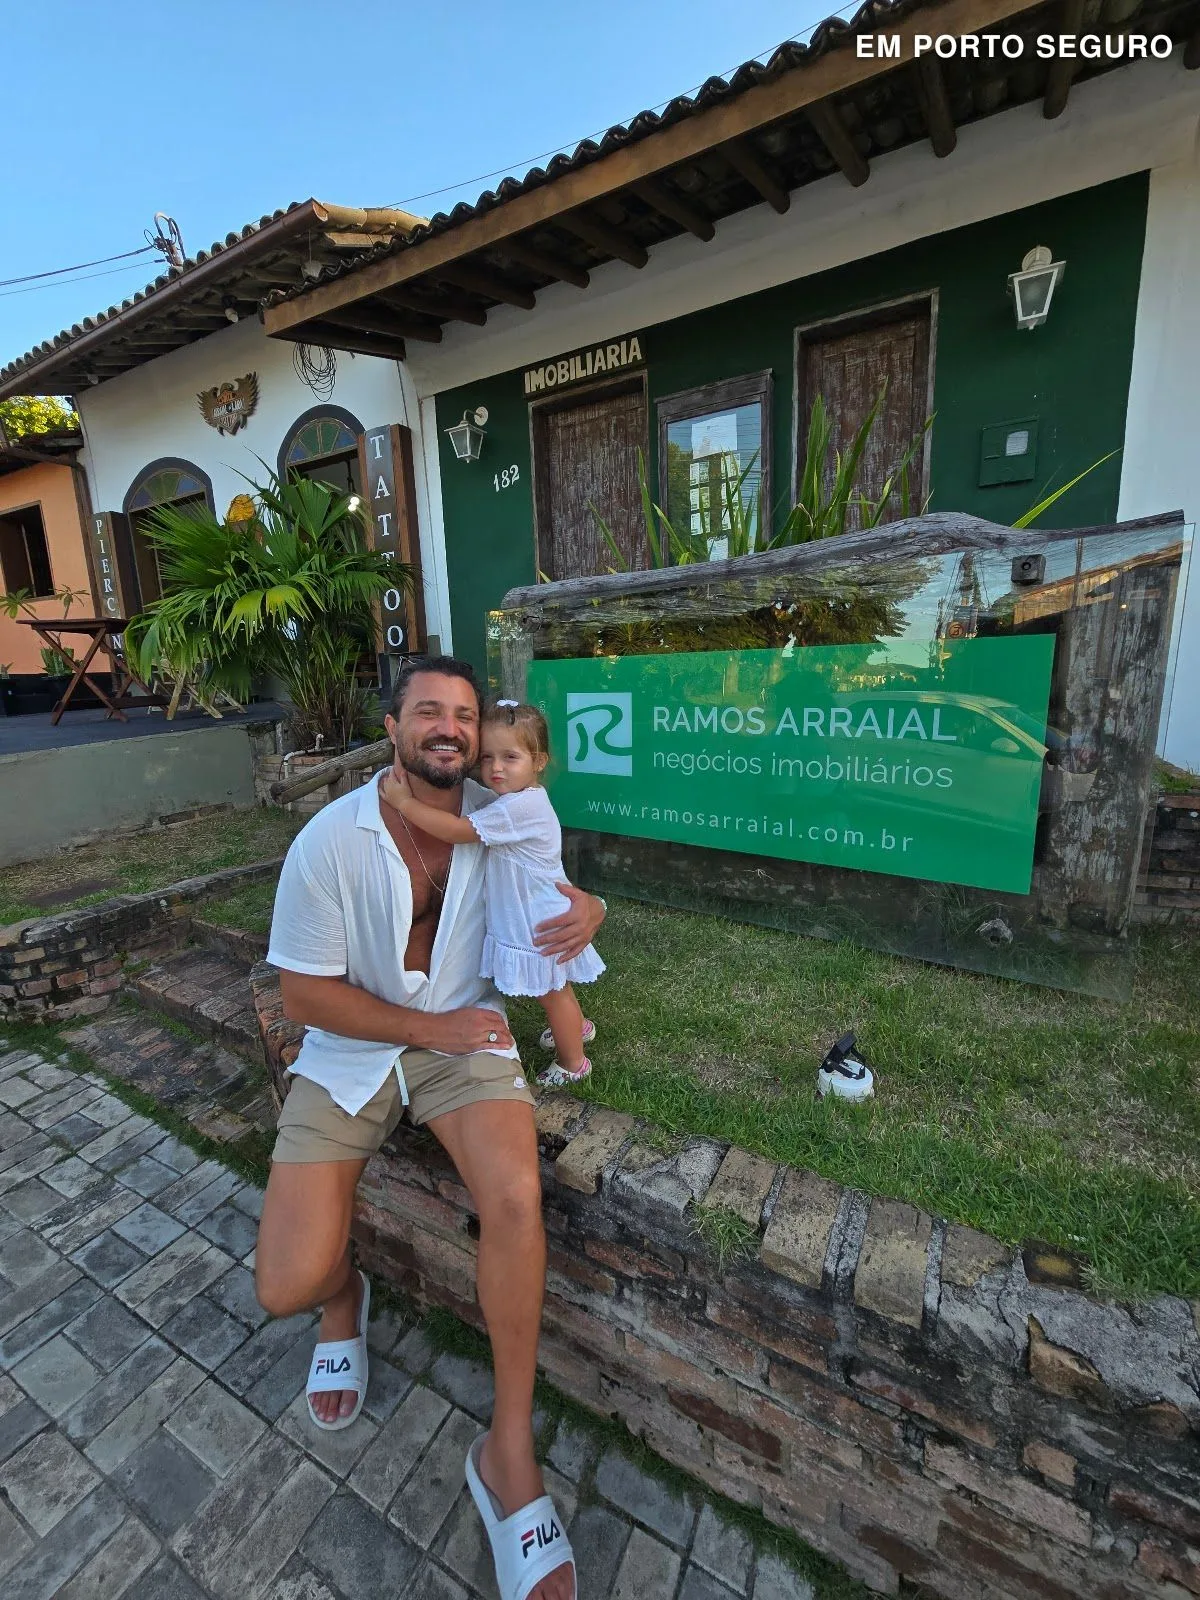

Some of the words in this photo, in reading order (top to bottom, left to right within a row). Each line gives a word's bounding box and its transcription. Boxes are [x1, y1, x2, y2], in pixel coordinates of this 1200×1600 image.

[524, 337, 643, 394] IMOBILIARIA
[493, 464, 520, 492] 182
[369, 434, 404, 647] TATTOO
[95, 519, 124, 660] PIERCN
[653, 706, 766, 735] RAMOS
[775, 707, 957, 741] ARRAIAL
[653, 749, 762, 776] negócios
[771, 752, 953, 788] imobiliários
[587, 800, 913, 852] www.ramosarraial.com.br
[315, 1356, 351, 1375] FILA
[521, 1518, 561, 1559] FILA
